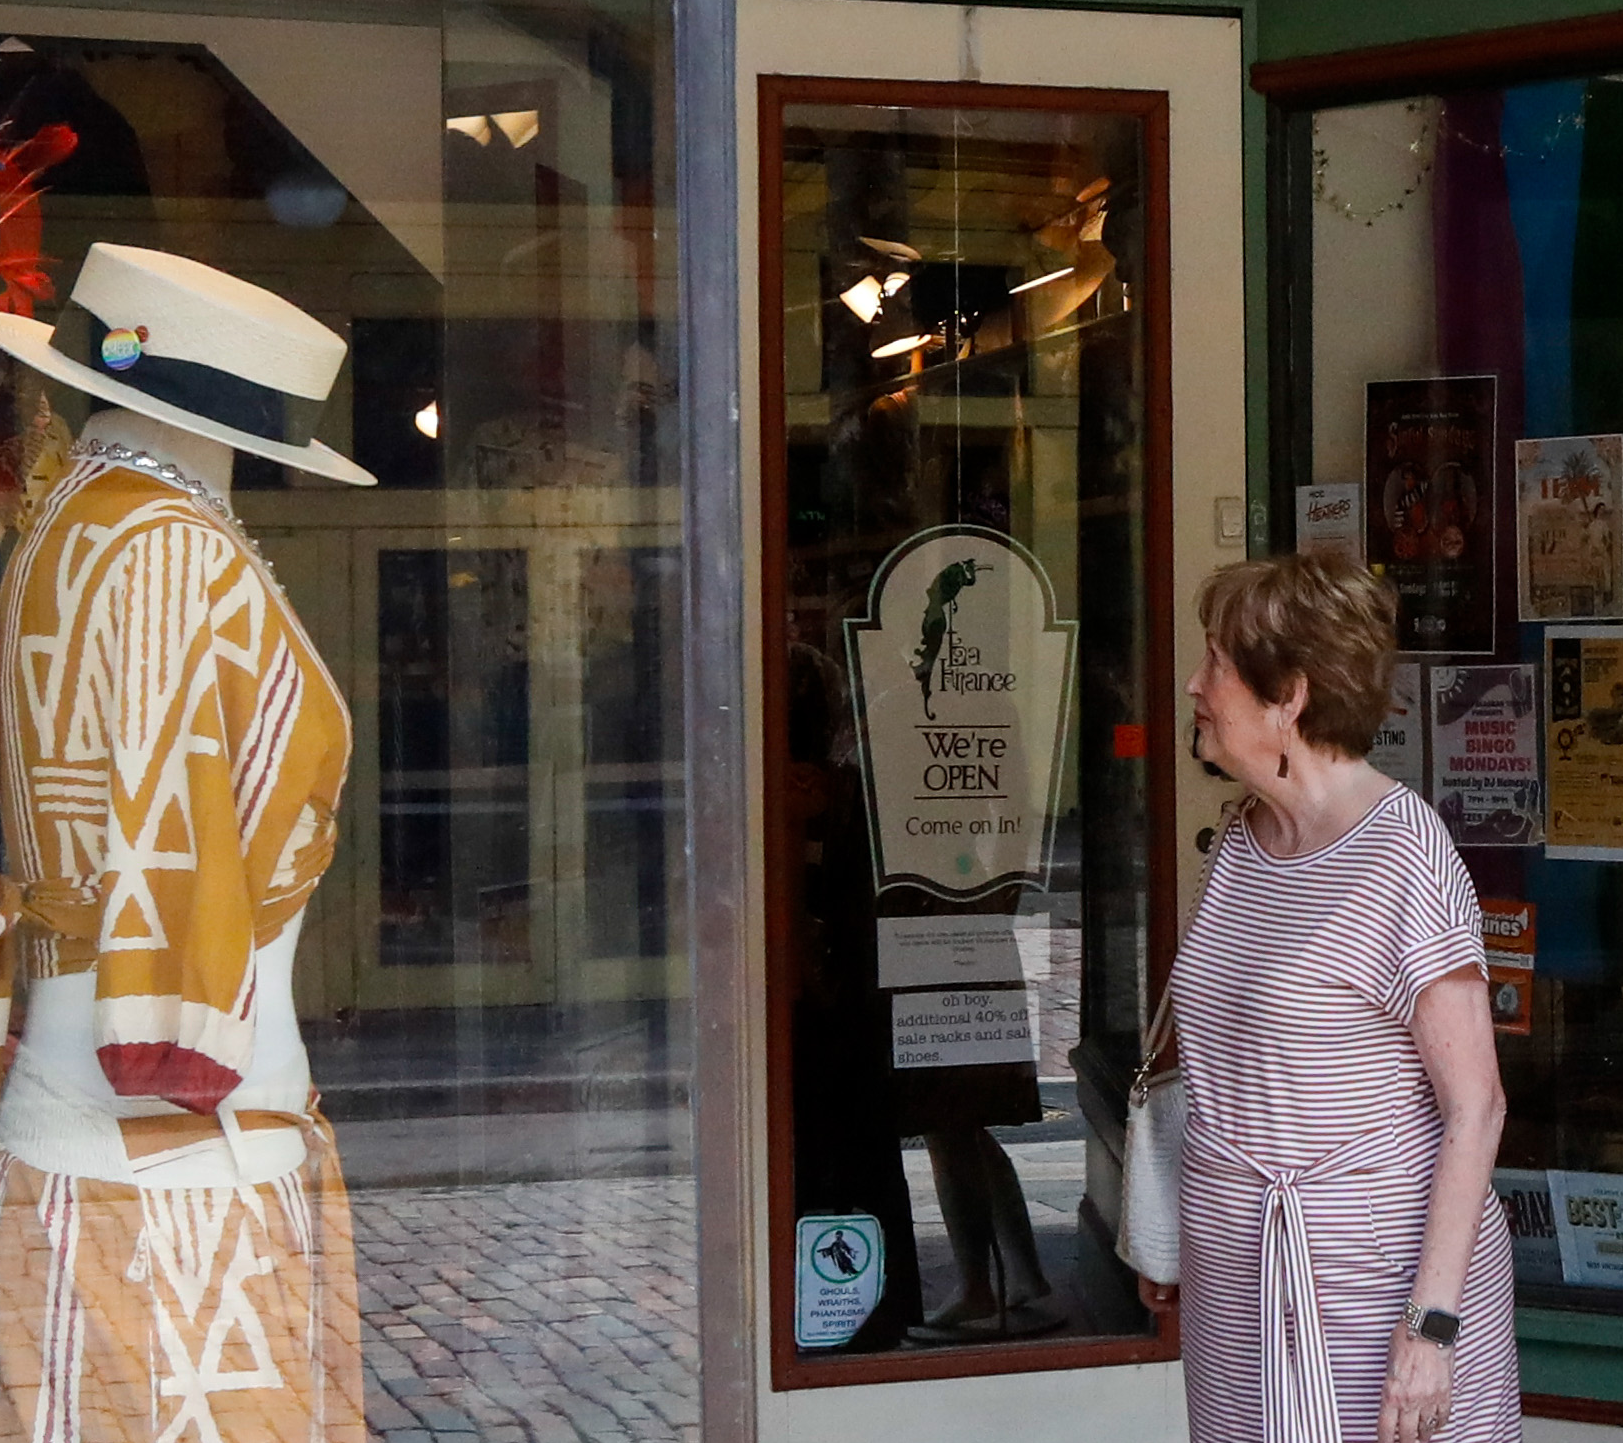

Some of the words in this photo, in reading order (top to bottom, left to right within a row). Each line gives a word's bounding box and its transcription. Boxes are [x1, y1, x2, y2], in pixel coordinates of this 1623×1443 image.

[1465, 720, 1517, 735] MUSIC
[921, 731, 1008, 758] We're
[1372, 730, 1406, 746] STING
[1465, 739, 1516, 754] BINGO
[1449, 757, 1532, 773] MONDAYS!
[923, 764, 1000, 791] OPEN
[1484, 777, 1496, 788] DJ
[905, 816, 963, 836] Come
[969, 819, 992, 835] on
[998, 815, 1022, 835] In!
[1481, 919, 1521, 937] unes
[942, 994, 960, 1007] oh
[964, 993, 994, 1007] boy.
[896, 1011, 971, 1028] additional
[975, 1009, 1007, 1023] 40%
[897, 1032, 927, 1046] sale
[930, 1029, 972, 1044] racks
[974, 1028, 1002, 1041] and
[898, 1049, 944, 1064] shoes.
[1565, 1195, 1619, 1230] BEST
